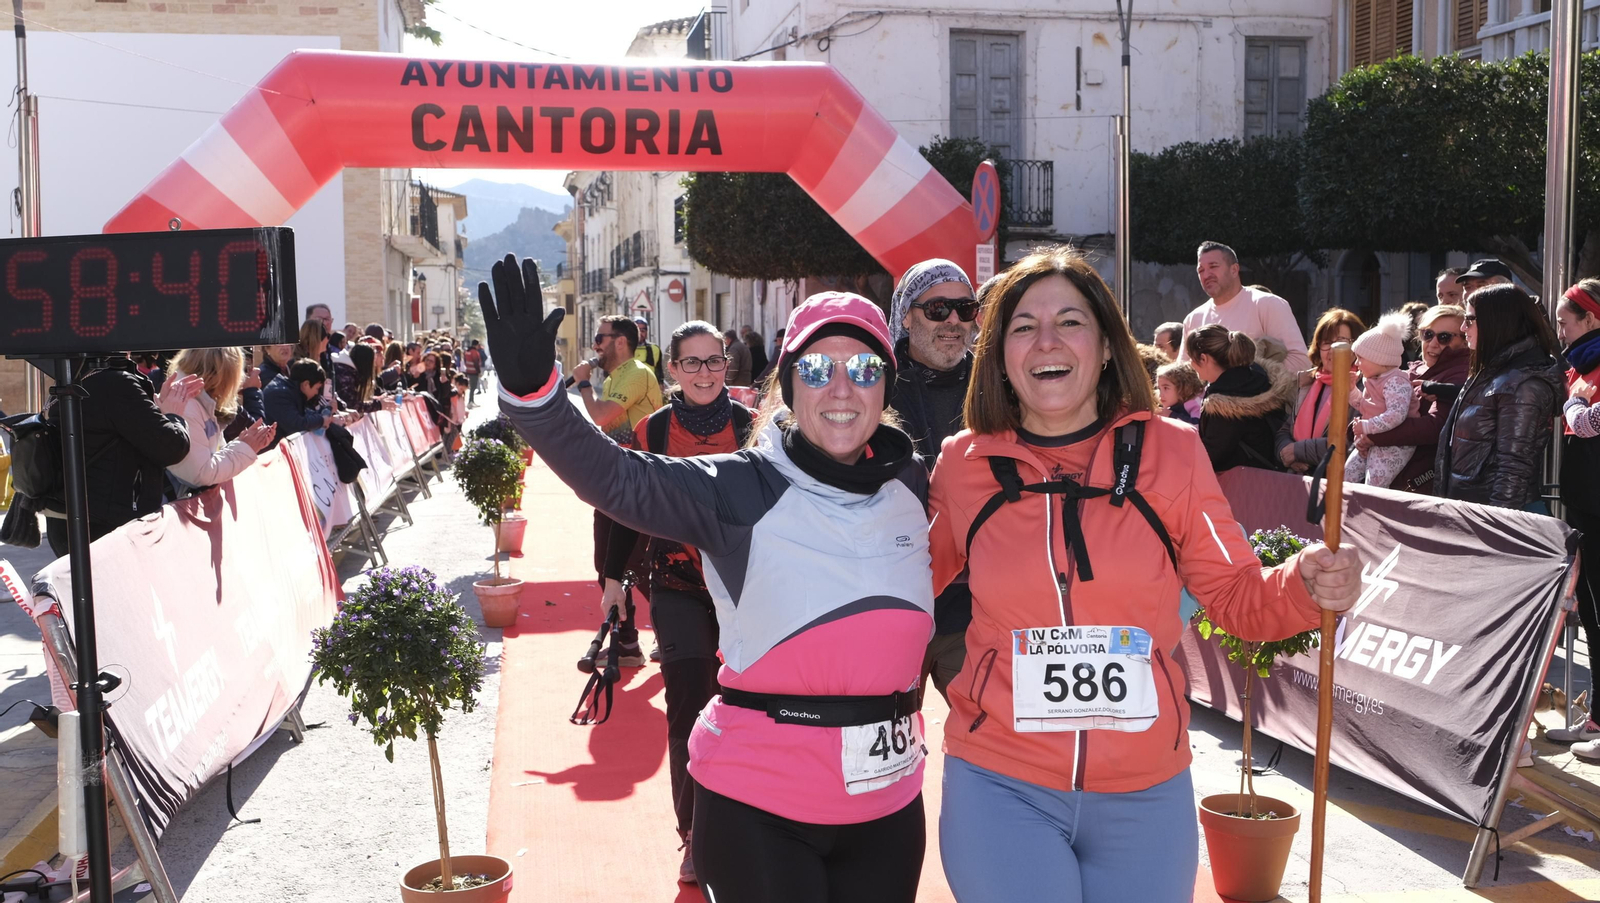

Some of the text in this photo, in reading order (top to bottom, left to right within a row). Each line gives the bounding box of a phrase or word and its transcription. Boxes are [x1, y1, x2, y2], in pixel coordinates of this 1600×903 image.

[400, 60, 734, 94] AYUNTAMIENTO
[411, 103, 723, 156] CANTORIA
[6, 240, 269, 338] 58:40
[1029, 644, 1044, 655] LA
[1047, 642, 1107, 655] PÓLVORA
[1031, 628, 1083, 641] IV CxM
[1043, 661, 1128, 703] 586
[144, 644, 226, 761] TEAMERGY
[779, 708, 821, 720] Quechua
